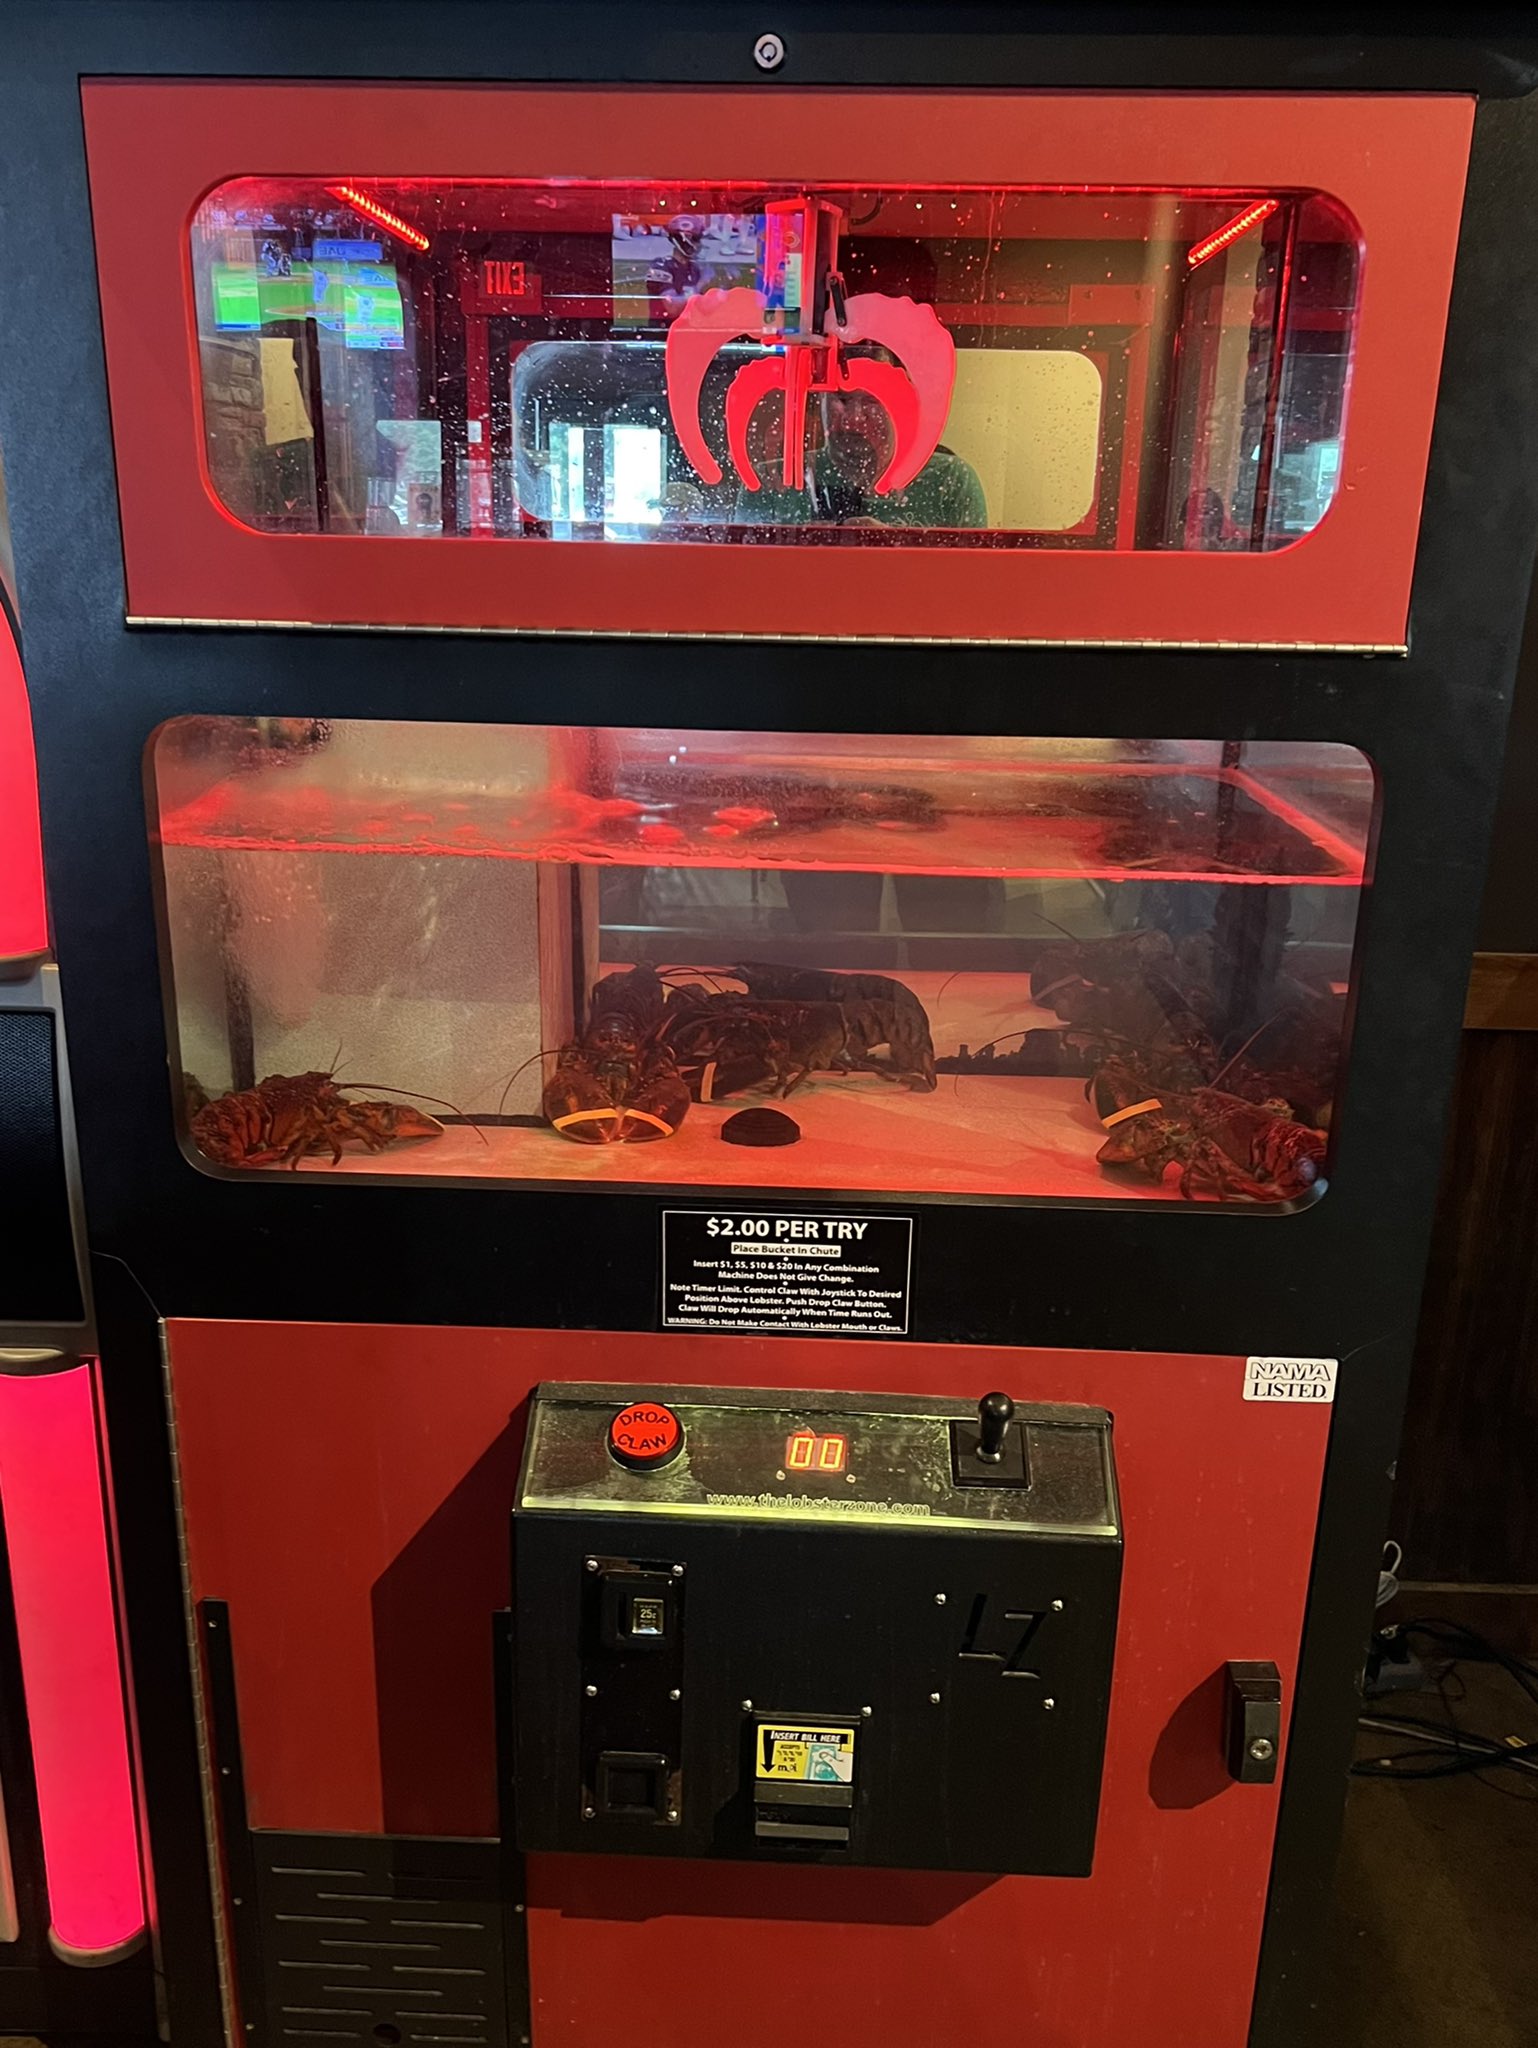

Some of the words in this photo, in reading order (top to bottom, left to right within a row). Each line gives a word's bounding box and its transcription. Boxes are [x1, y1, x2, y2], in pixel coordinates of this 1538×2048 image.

[706, 1216, 770, 1237] $2.00
[775, 1220, 819, 1238] PER
[822, 1221, 868, 1240] TRY
[733, 1244, 759, 1253] Place
[761, 1245, 796, 1254] Bucket
[797, 1246, 807, 1254] In
[809, 1246, 839, 1256] Chute
[693, 1260, 718, 1268] Insert
[720, 1261, 733, 1269] $1,
[735, 1261, 748, 1269] $5,
[776, 1262, 793, 1270] $20
[804, 1263, 822, 1272] Any
[823, 1264, 880, 1273] Combination
[718, 1271, 755, 1279] Machine
[756, 1272, 778, 1280] Does
[797, 1273, 817, 1281] Give
[818, 1274, 854, 1284] Change.
[670, 1283, 691, 1291] Note
[692, 1284, 716, 1292] Timer
[718, 1284, 742, 1293] Limit.
[743, 1285, 776, 1294] Control
[777, 1287, 798, 1295] Claw
[799, 1287, 820, 1295] With
[821, 1288, 856, 1298] Joystick
[857, 1289, 868, 1297] To
[868, 1290, 902, 1298] Desired
[685, 1294, 720, 1302] Position
[720, 1295, 748, 1303] Above
[750, 1296, 784, 1305] Lobster.
[785, 1297, 807, 1305] Push
[808, 1298, 831, 1307] Drop
[831, 1299, 853, 1307] Claw
[854, 1299, 887, 1308] Button.
[678, 1304, 699, 1312] Claw
[700, 1304, 717, 1312] Will
[718, 1305, 740, 1314] Drop
[740, 1306, 801, 1316] Automatically
[801, 1308, 827, 1316] When
[828, 1309, 850, 1317] Time
[851, 1309, 872, 1318] Runs
[873, 1310, 892, 1318] Out.
[667, 1317, 707, 1325] WARNING:
[721, 1318, 736, 1326] Not
[736, 1319, 758, 1327] Make
[841, 1323, 868, 1331] Mouth
[1250, 1362, 1331, 1381] NAMA
[619, 1411, 670, 1426] DROP
[617, 1433, 667, 1450] CLAW
[788, 1437, 843, 1469] 00
[706, 1492, 931, 1516] www.thelobsterzone.com
[770, 1730, 799, 1741] INSERT
[801, 1733, 818, 1742] BILL
[820, 1734, 841, 1743] HERE
